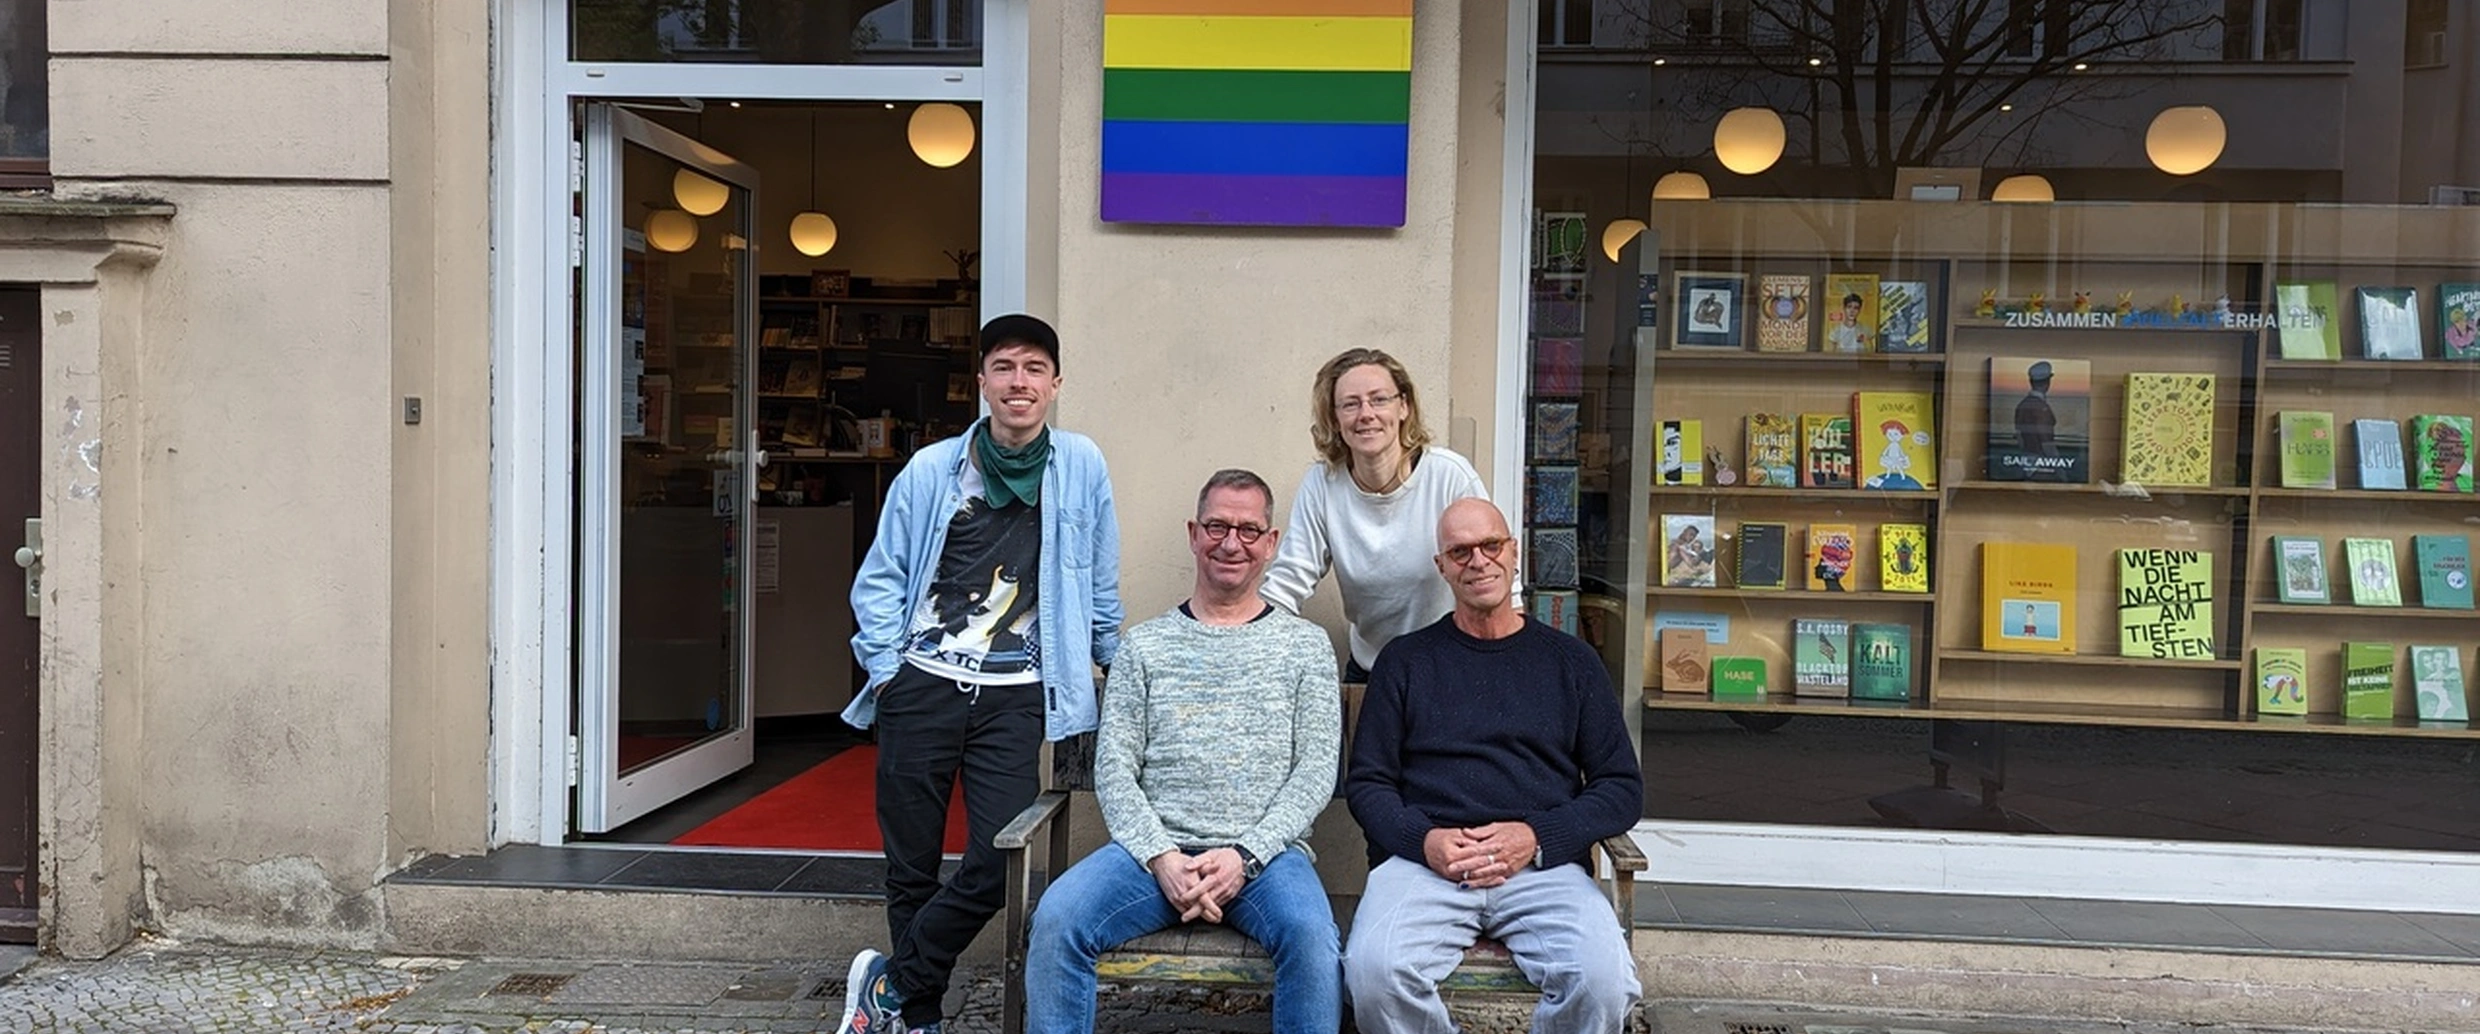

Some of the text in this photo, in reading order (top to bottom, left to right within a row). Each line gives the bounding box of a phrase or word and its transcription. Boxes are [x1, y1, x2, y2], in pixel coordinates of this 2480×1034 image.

[1762, 283, 1809, 299] SETZ
[1760, 320, 1808, 330] MONDE
[2005, 312, 2116, 328] ZUSAMMEN
[2223, 312, 2326, 329] ERHALTEN
[1753, 433, 1790, 446] LICHTE
[2003, 455, 2076, 468] SAIL AWAY
[2124, 549, 2198, 568] WENN
[2144, 566, 2183, 585] DIE
[2125, 582, 2206, 605] NACHT
[2159, 603, 2196, 622] AM
[1817, 624, 1849, 635] COSBY
[2124, 622, 2187, 643] TIEF-
[1860, 643, 1902, 666] KALT
[2152, 637, 2215, 659] STEN
[1724, 671, 1755, 681] HASE
[1858, 665, 1904, 678] SOMMER
[1797, 674, 1849, 686] WASTELAND
